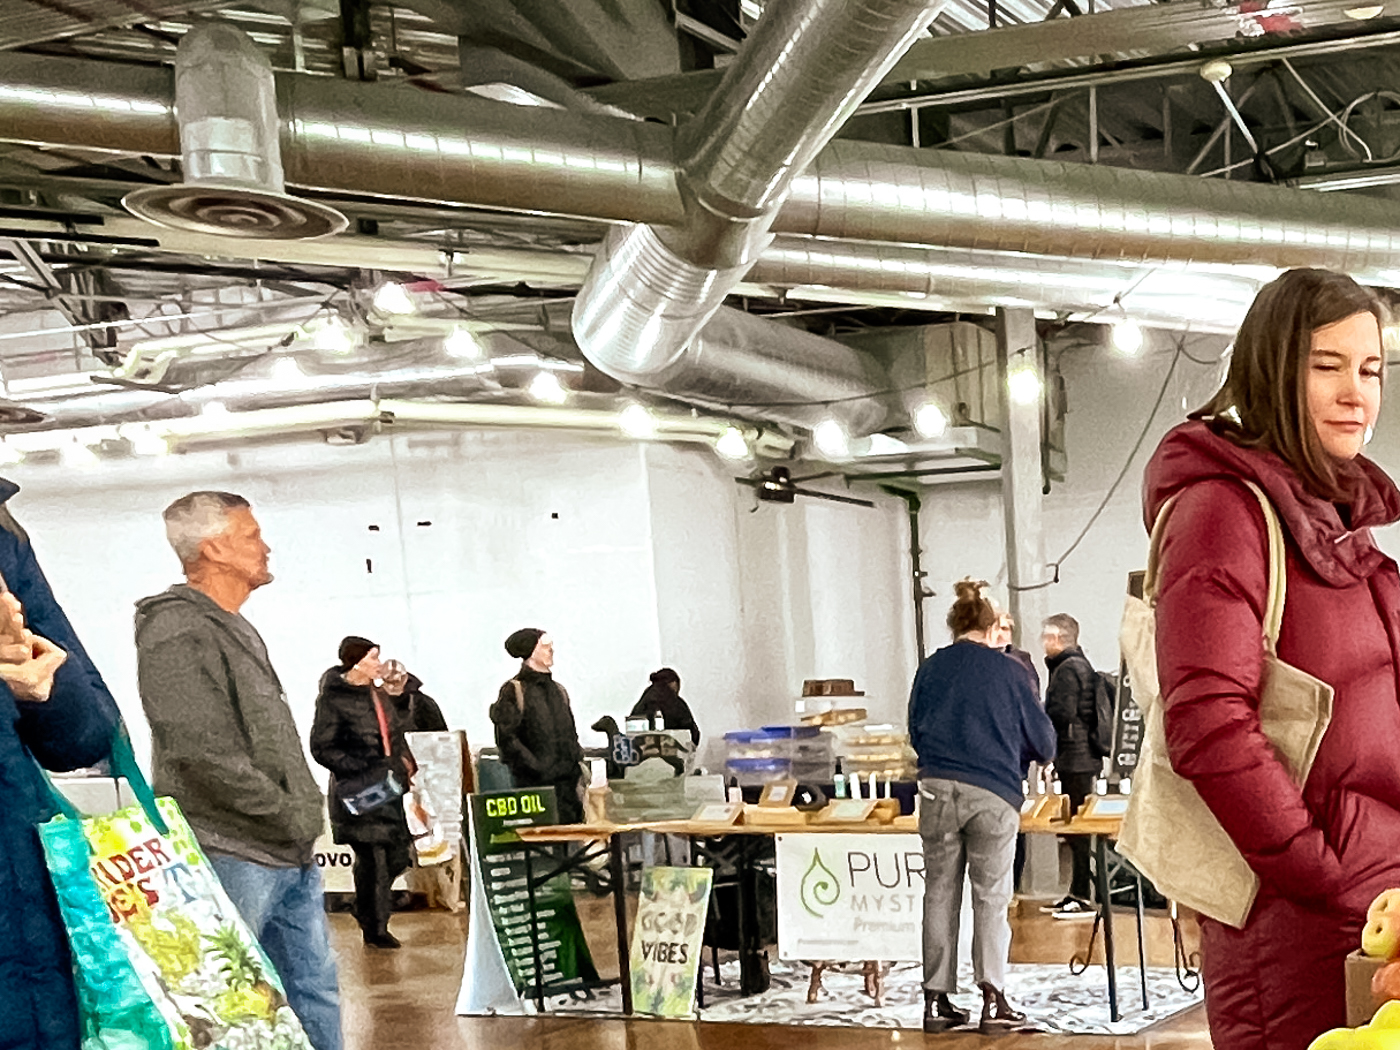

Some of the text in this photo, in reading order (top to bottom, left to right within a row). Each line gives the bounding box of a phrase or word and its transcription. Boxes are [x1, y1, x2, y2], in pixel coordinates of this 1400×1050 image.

[486, 795, 546, 817] CBD OIL
[851, 894, 915, 912] MYST
[641, 940, 689, 964] VIBES
